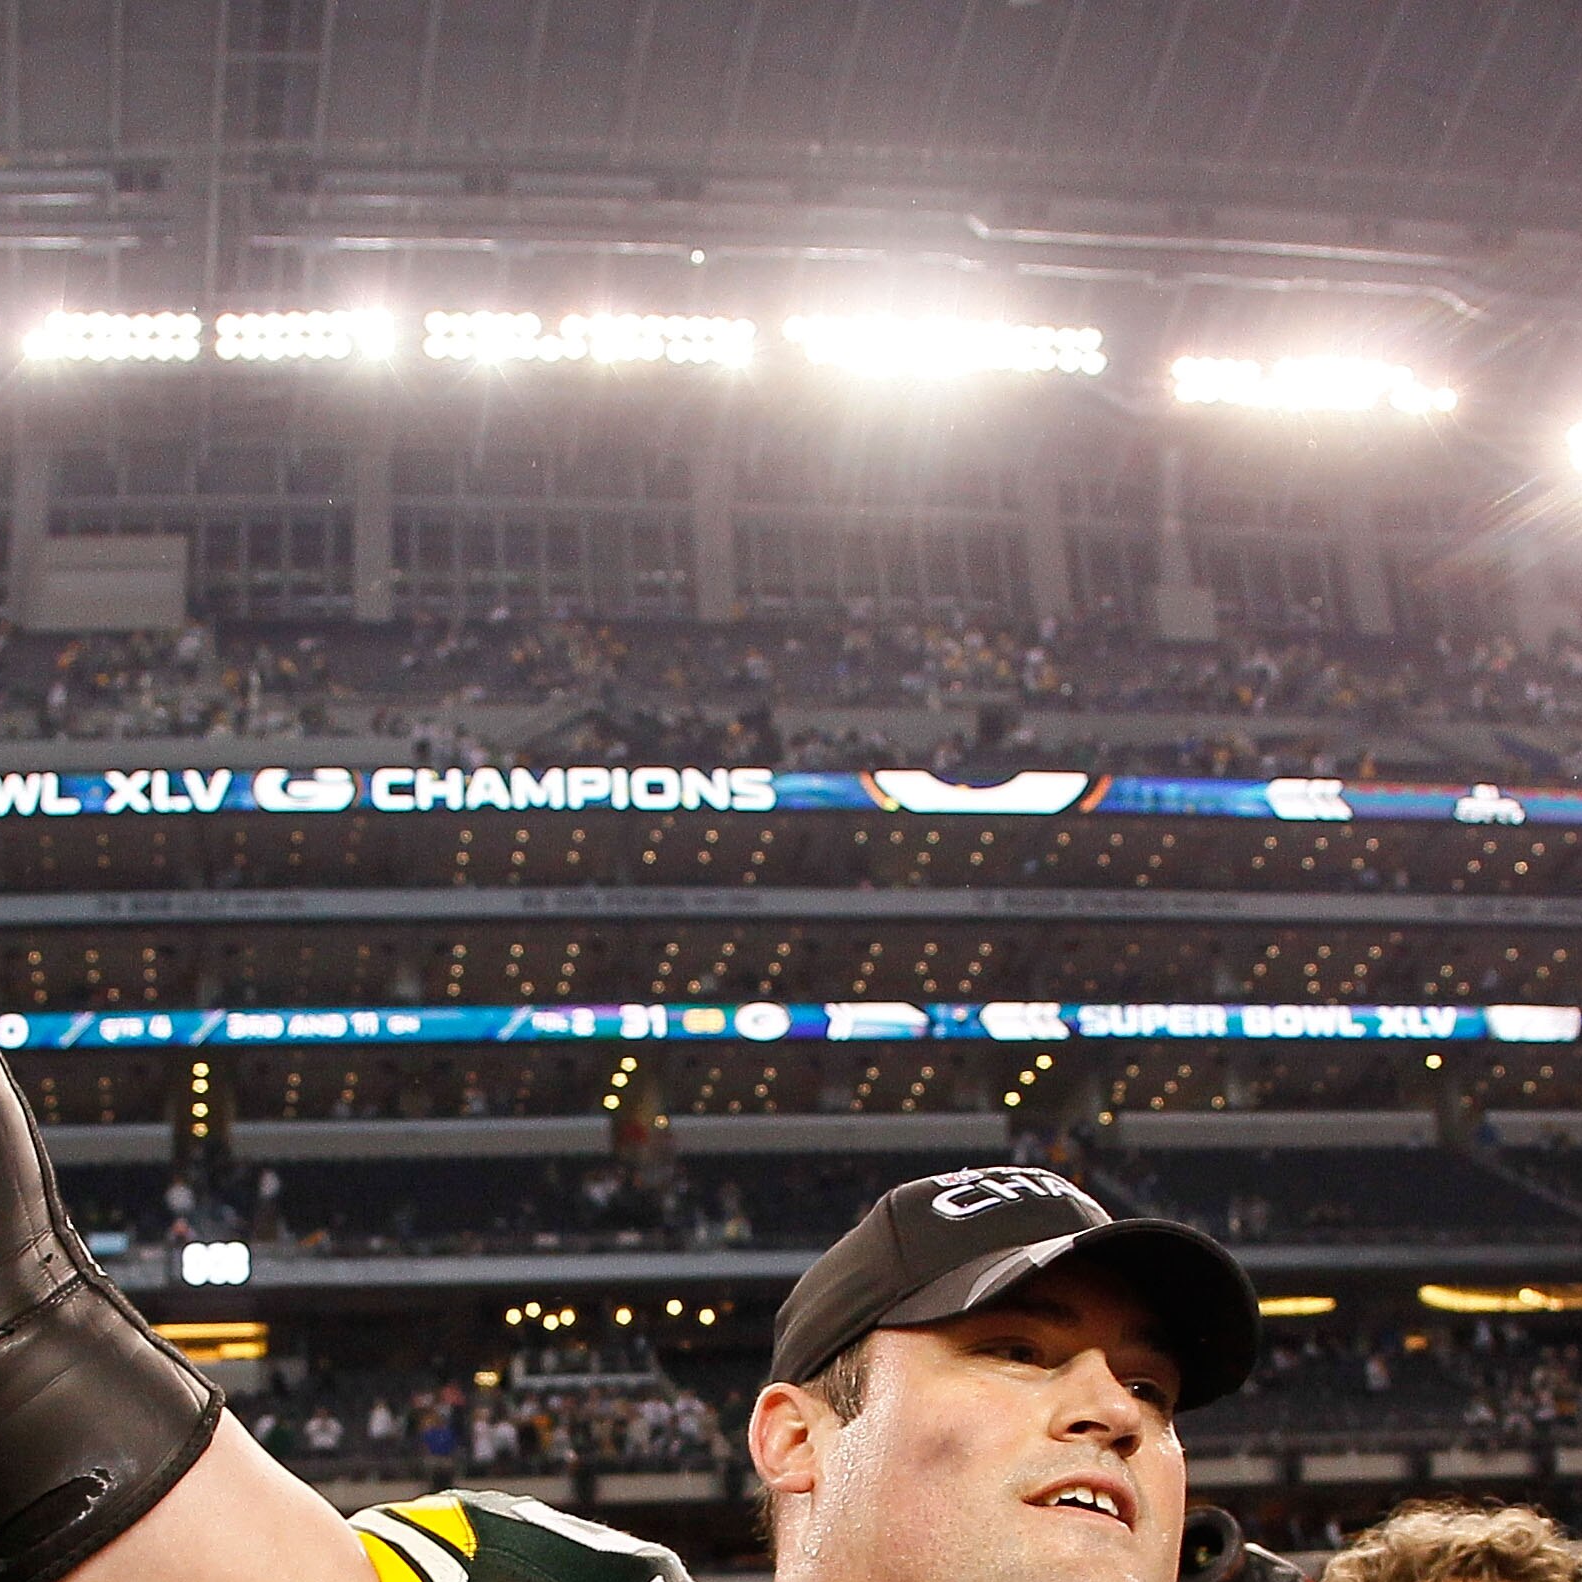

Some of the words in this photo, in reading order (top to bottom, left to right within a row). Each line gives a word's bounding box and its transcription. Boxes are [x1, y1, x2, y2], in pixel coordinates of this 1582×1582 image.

[104, 768, 233, 815] XLV
[381, 766, 777, 812] CHAMPIONS
[1078, 1003, 1226, 1039] SUPER
[1243, 1004, 1366, 1039] BOWL
[1376, 1005, 1458, 1039] XLV
